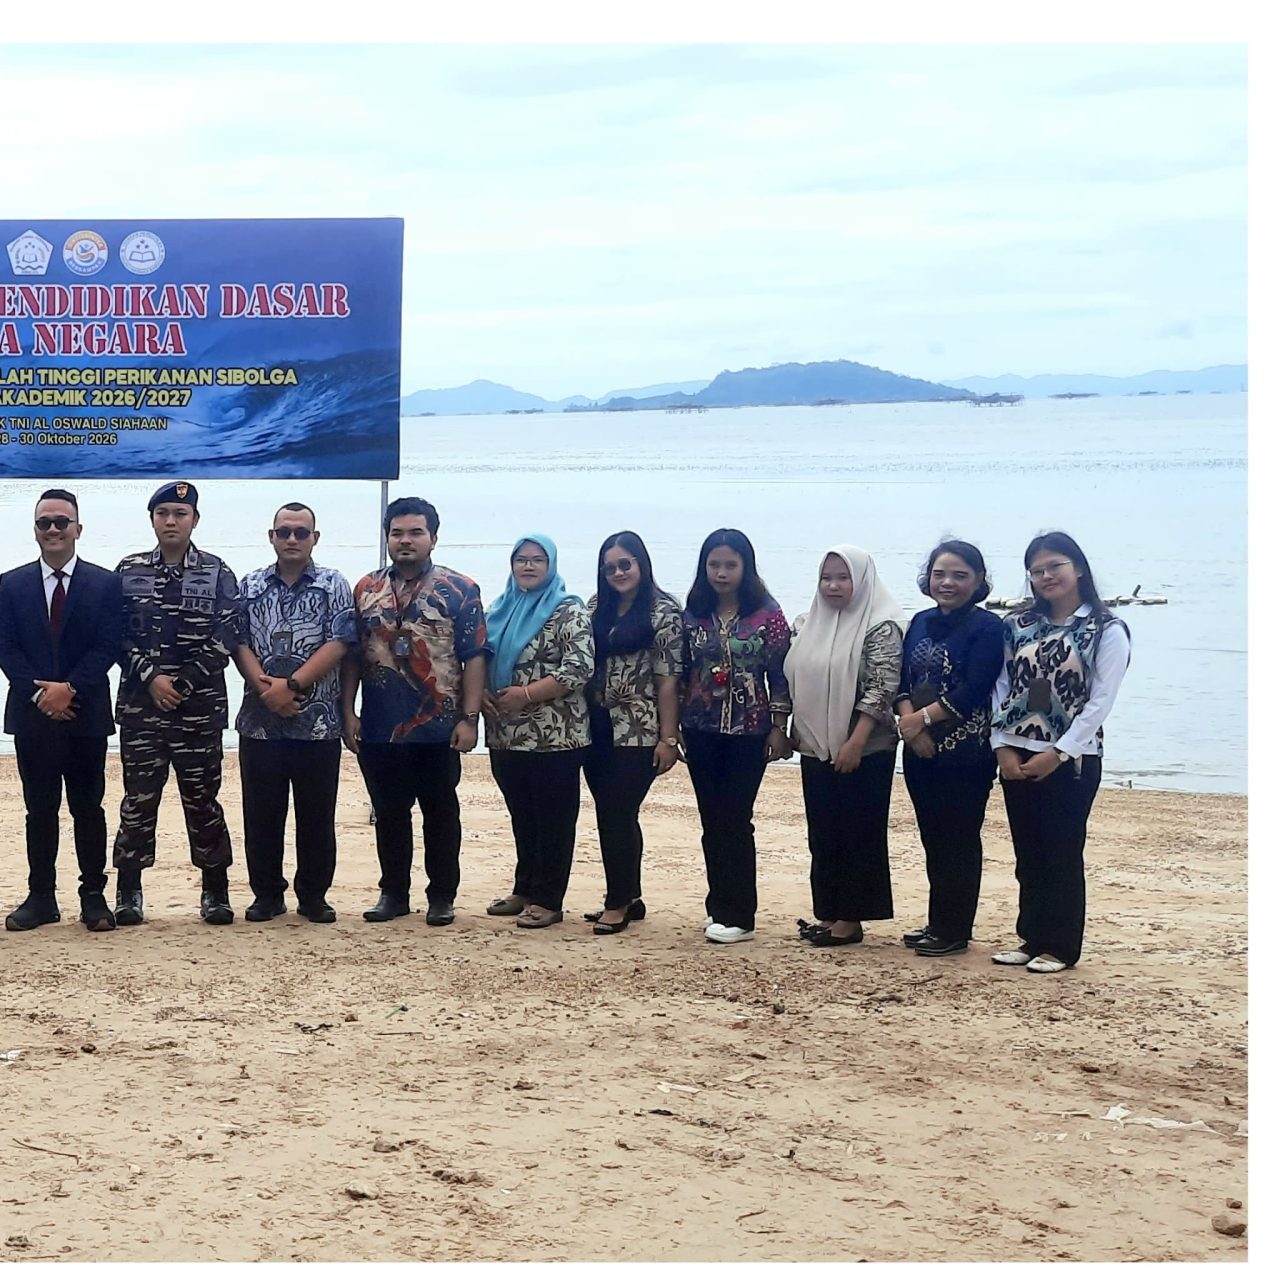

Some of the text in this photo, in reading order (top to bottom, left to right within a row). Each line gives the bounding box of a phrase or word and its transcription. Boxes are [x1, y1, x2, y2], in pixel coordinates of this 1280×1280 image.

[219, 284, 350, 318] DASAR
[32, 322, 187, 356] NEGARA
[37, 368, 101, 385] TINGGI
[104, 368, 213, 386] PERIKANAN
[216, 368, 298, 386] SIBOLGA
[91, 388, 192, 410] 2026/2027
[8, 417, 30, 430] TNI
[33, 417, 49, 430] AL
[52, 417, 107, 430] OSWALD
[110, 417, 168, 430] SIAHAAN
[19, 433, 34, 445] 30
[37, 433, 86, 445] Oktober
[88, 433, 118, 445] 2026
[201, 588, 212, 597] AL
